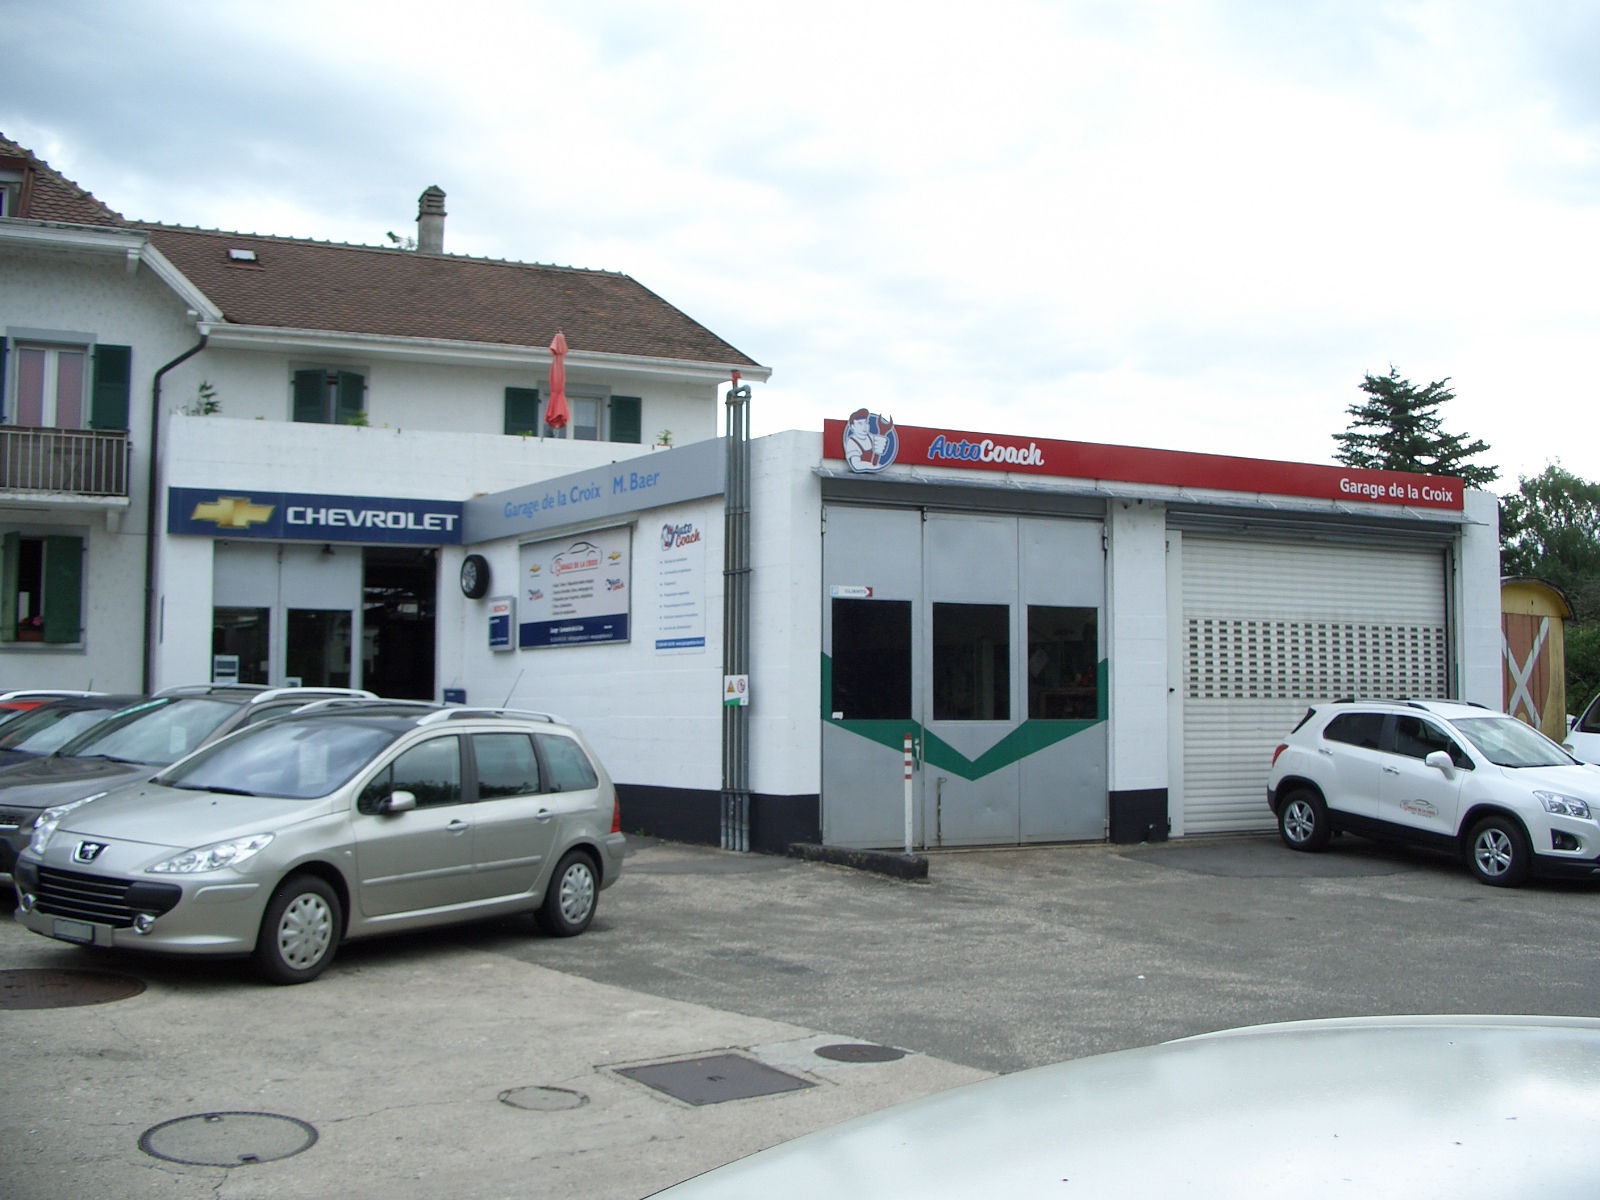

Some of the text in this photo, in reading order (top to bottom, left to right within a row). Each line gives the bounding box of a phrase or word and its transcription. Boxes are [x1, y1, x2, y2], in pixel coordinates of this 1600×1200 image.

[927, 435, 1044, 466] AutoCoach
[504, 472, 660, 518] Garage de la Croix M. Baer
[1340, 478, 1453, 502] Garage de la Croix
[286, 506, 458, 531] CHEVROLET
[673, 523, 693, 536] Auto
[675, 528, 701, 547] Coach
